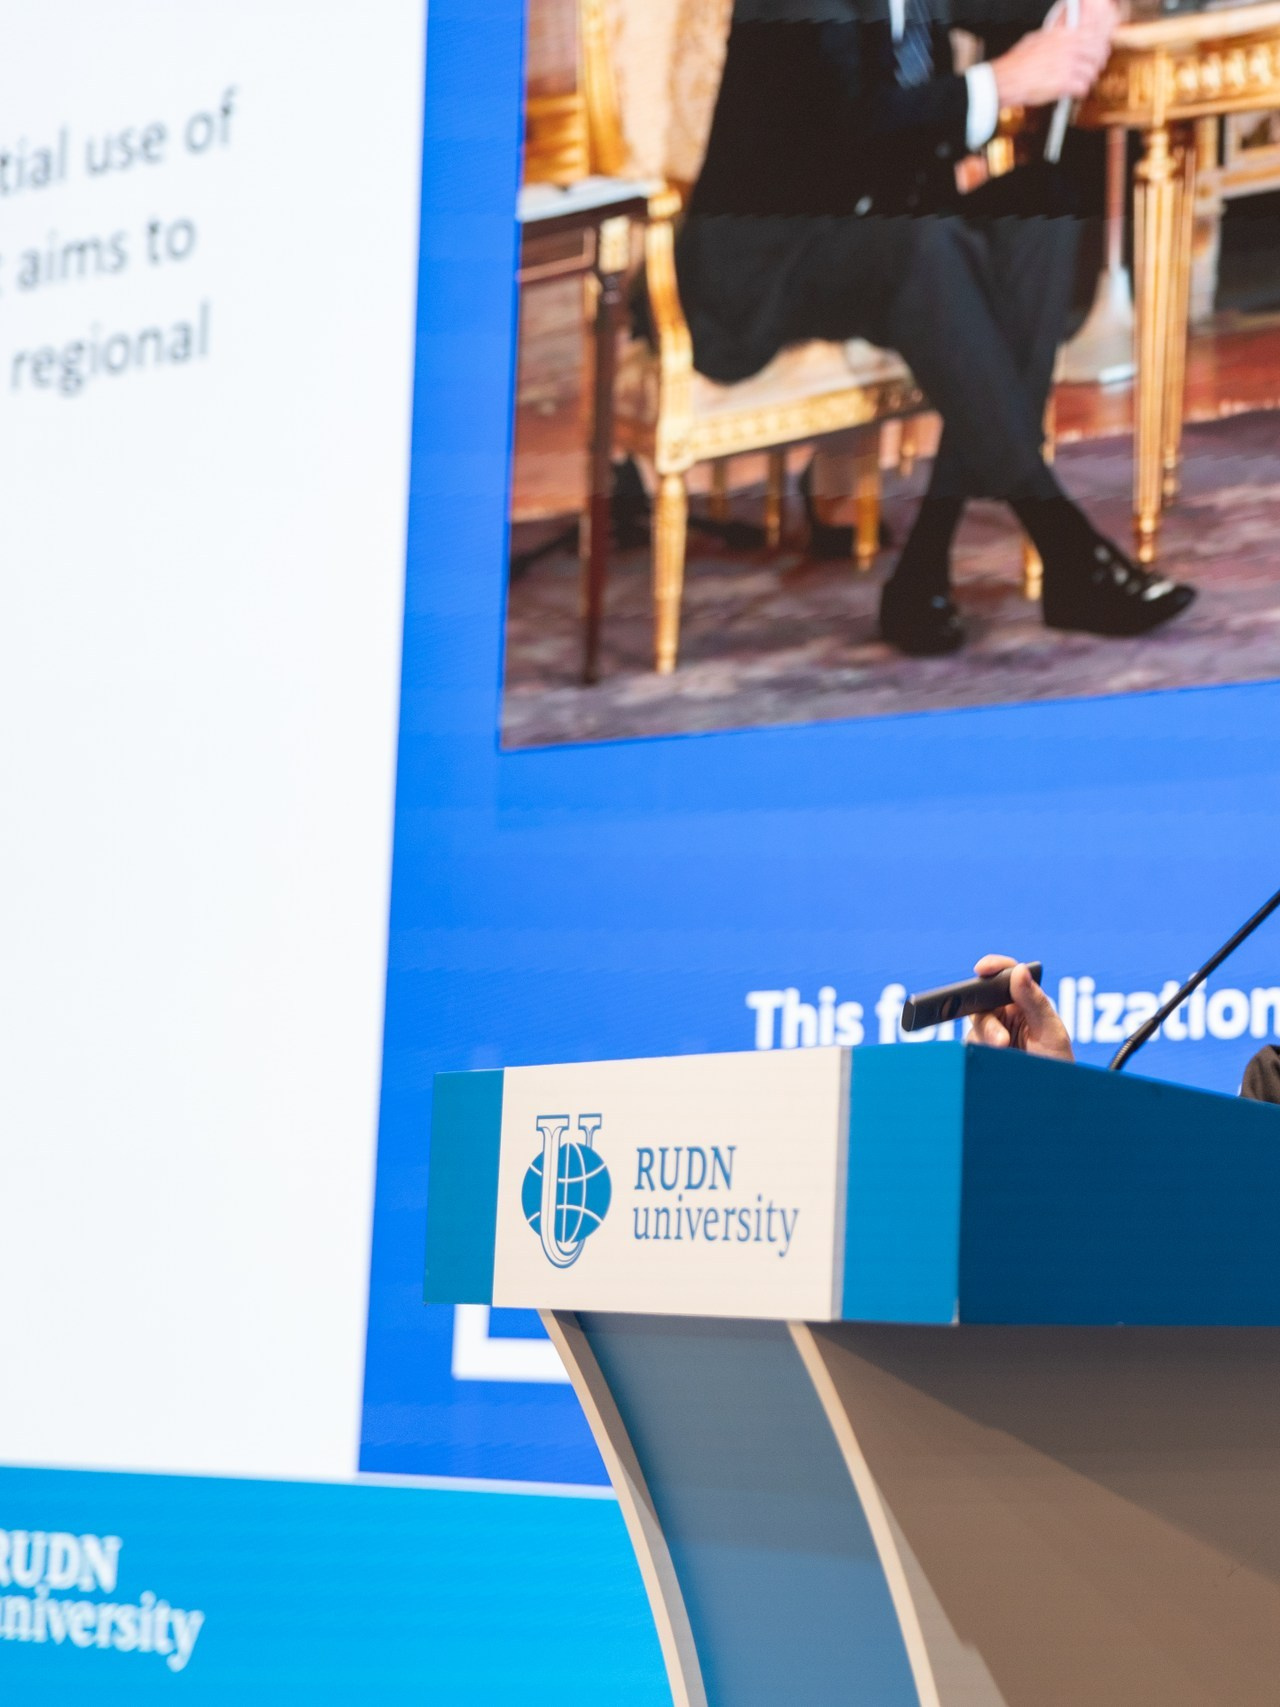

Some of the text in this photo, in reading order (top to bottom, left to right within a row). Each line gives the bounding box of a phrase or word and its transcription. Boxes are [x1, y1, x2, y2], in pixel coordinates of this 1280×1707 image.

[0, 84, 237, 195] tial use of
[17, 230, 128, 291] aims
[146, 214, 196, 266] to
[12, 300, 209, 397] regional
[744, 987, 865, 1050] This
[634, 1145, 736, 1191] RUDN
[633, 1194, 799, 1257] university
[0, 1582, 205, 1672] niversity
